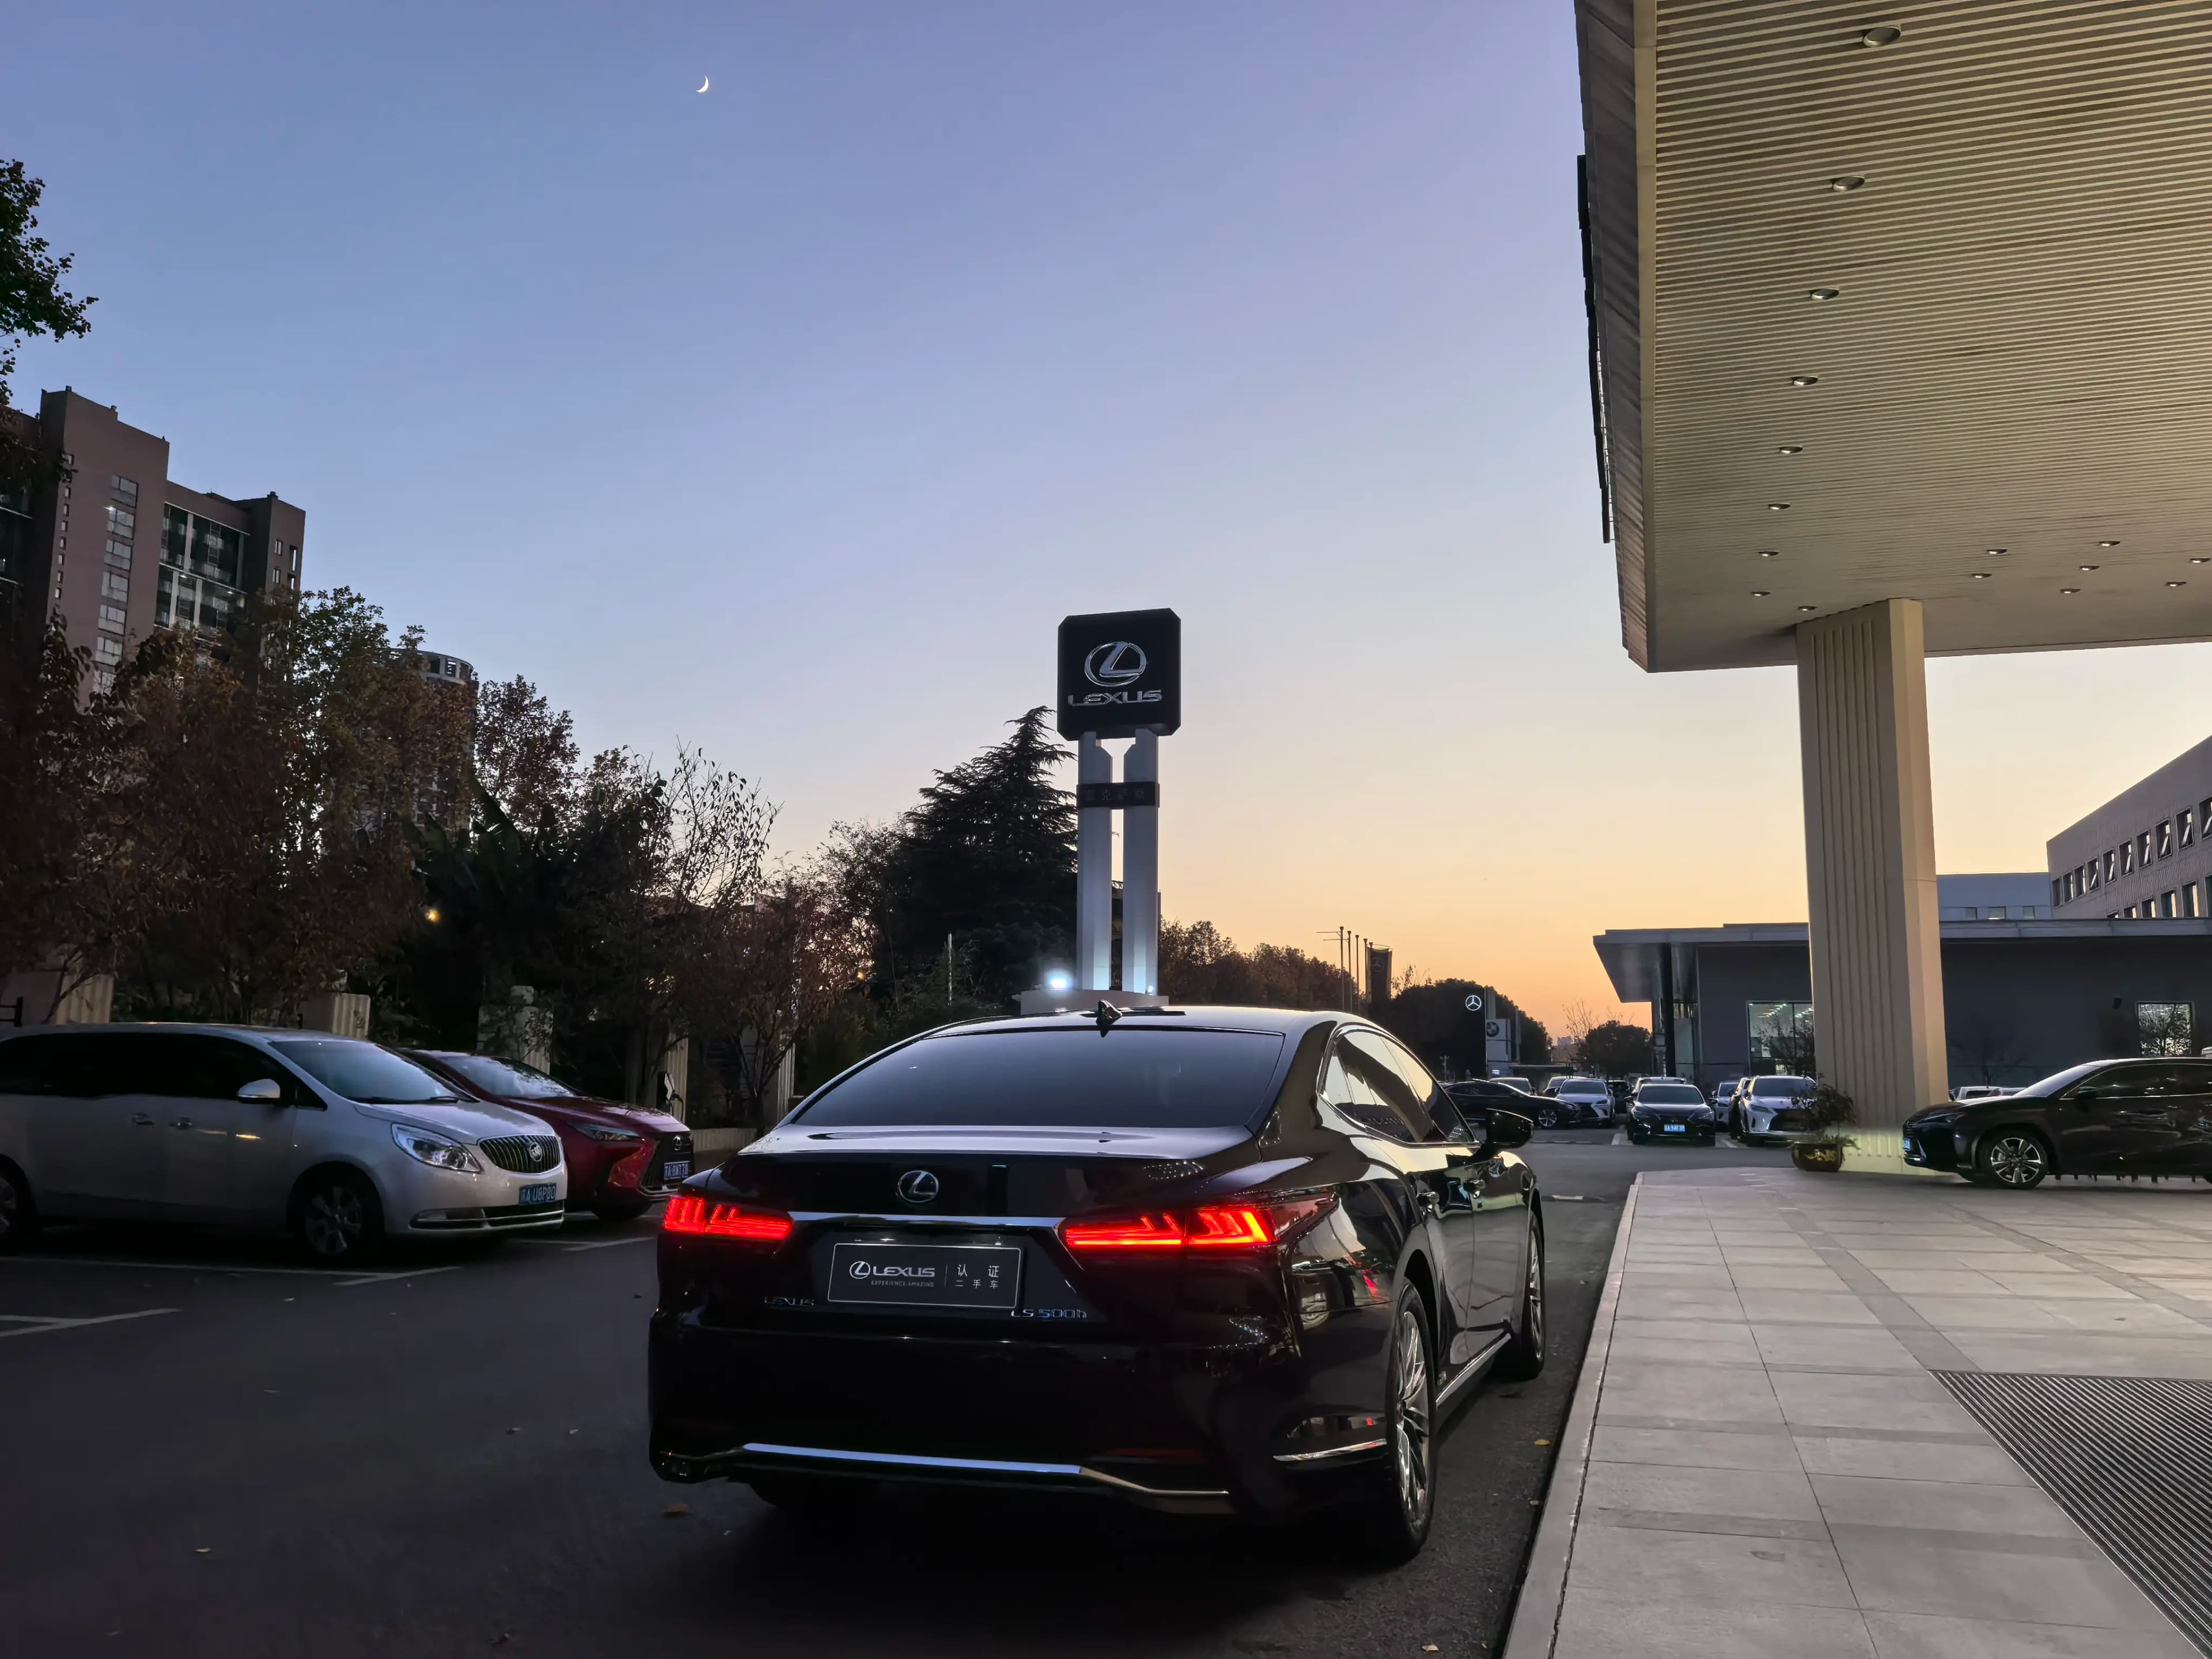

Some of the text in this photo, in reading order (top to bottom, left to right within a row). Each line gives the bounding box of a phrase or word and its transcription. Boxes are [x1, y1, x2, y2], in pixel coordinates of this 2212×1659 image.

[1067, 690, 1162, 706] LEXUS
[873, 1266, 935, 1278] LEXUS
[957, 1263, 1000, 1278] 认证
[955, 1279, 999, 1289] 二手车
[1010, 1308, 1087, 1319] LS 500h
